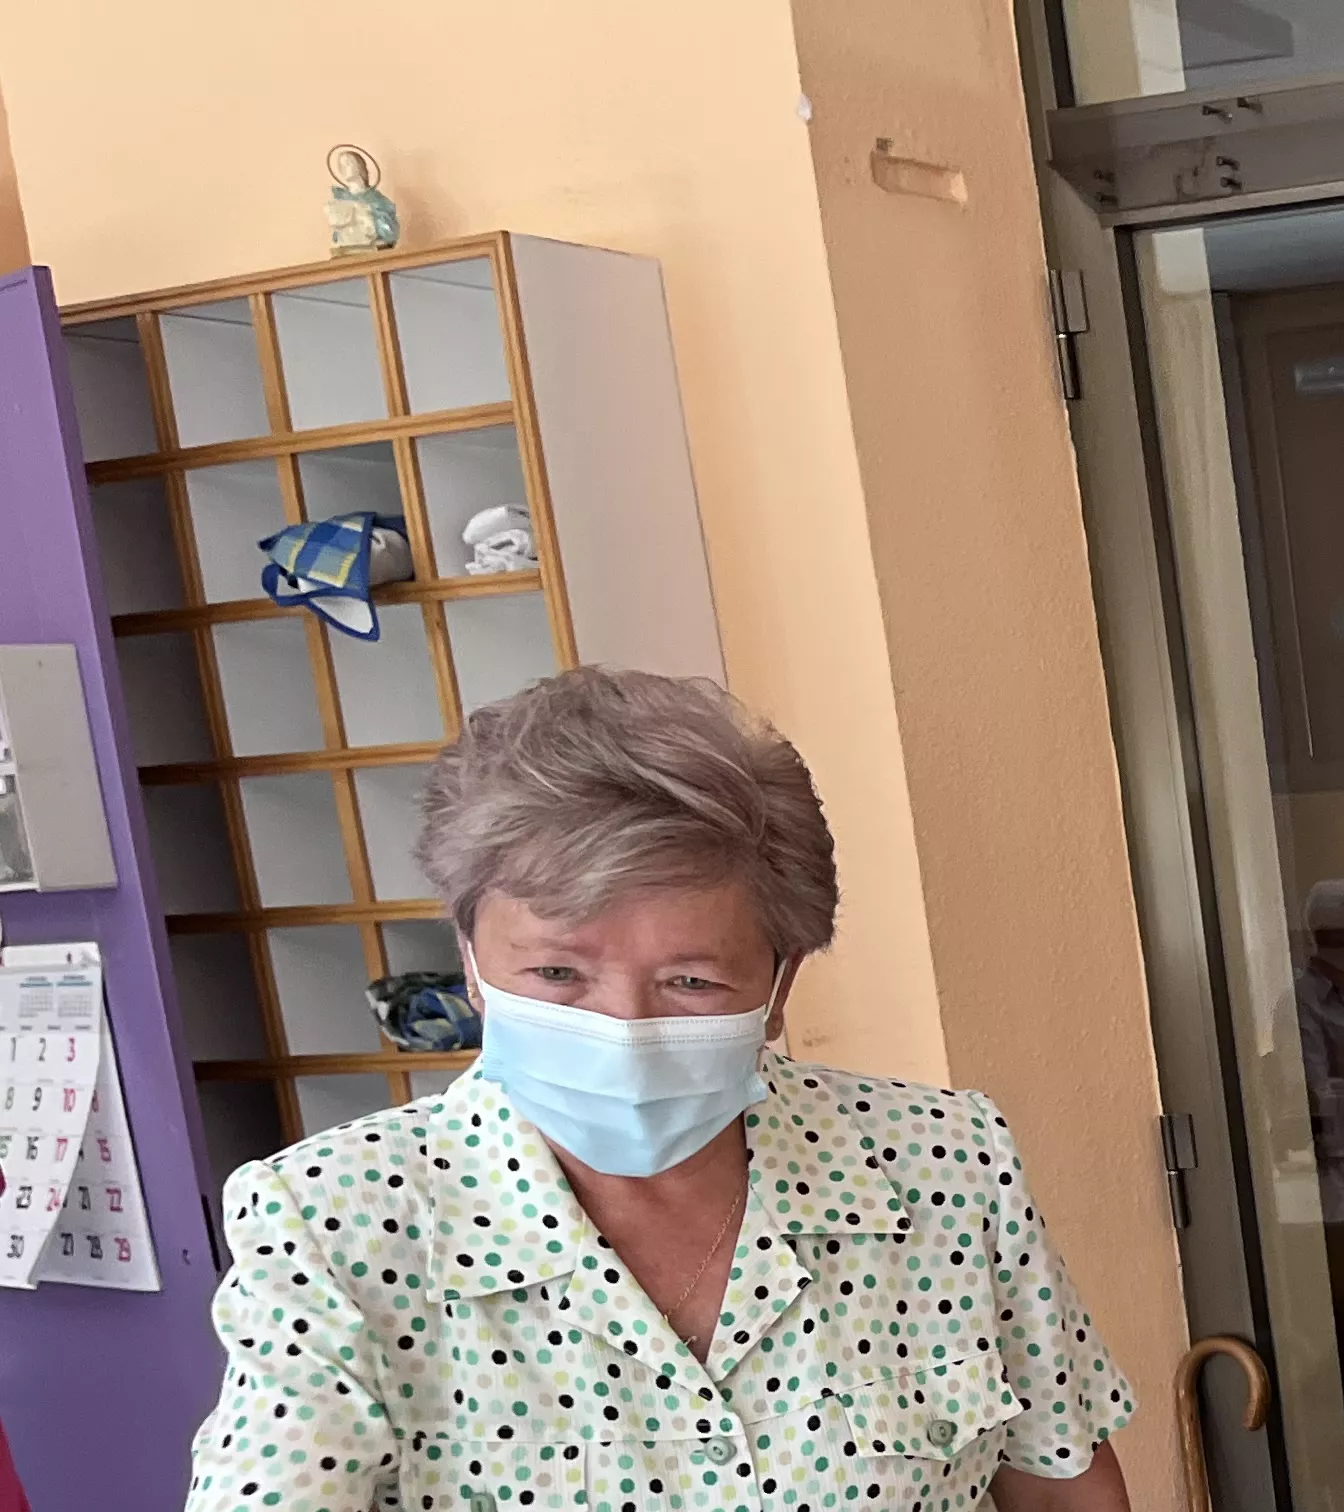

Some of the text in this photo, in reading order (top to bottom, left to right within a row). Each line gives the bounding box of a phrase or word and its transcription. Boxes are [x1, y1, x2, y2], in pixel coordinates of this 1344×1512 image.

[11, 1037, 76, 1062] 1 2 3
[32, 1086, 43, 1112] 9
[63, 1087, 77, 1113] 10
[26, 1135, 39, 1161] 16
[55, 1137, 68, 1162] 17
